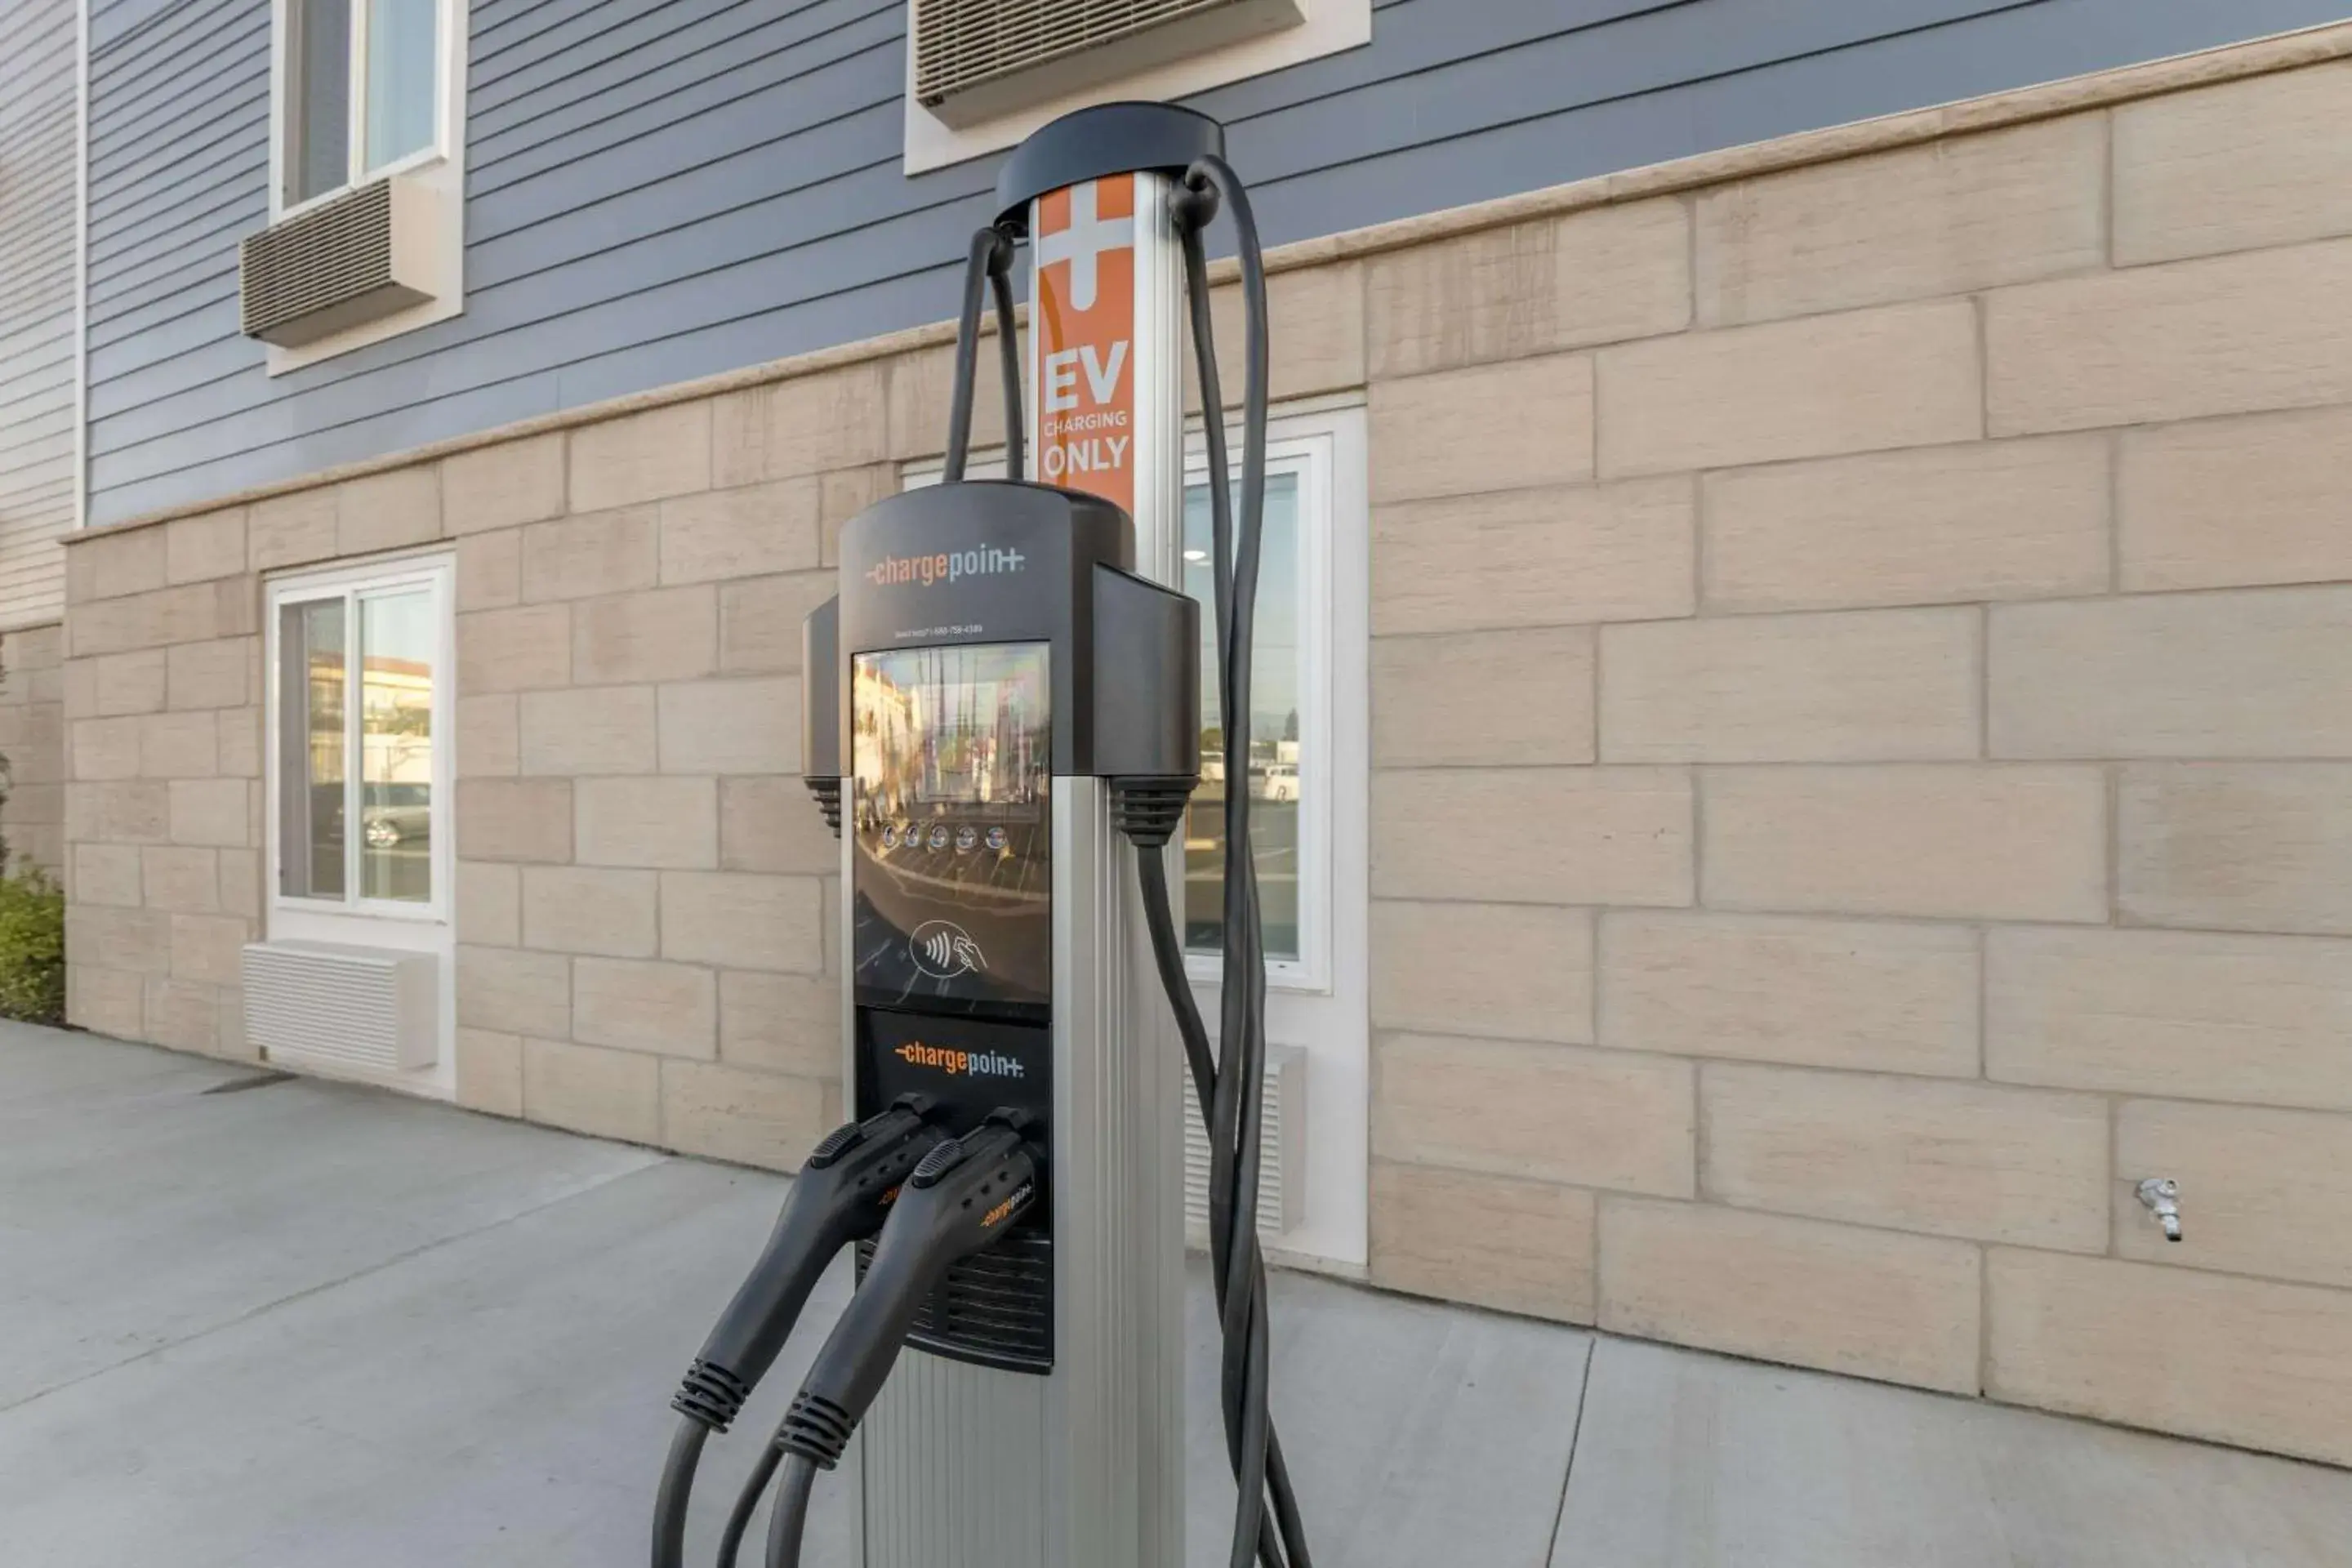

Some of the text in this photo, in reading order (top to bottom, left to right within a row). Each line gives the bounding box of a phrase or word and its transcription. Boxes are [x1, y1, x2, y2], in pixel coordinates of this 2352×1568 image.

[1045, 340, 1129, 414] EV
[1044, 410, 1128, 438] CHARGING
[1044, 436, 1129, 477] ONLY
[866, 543, 1025, 586] chargepoint
[895, 1040, 1025, 1078] chargepoint
